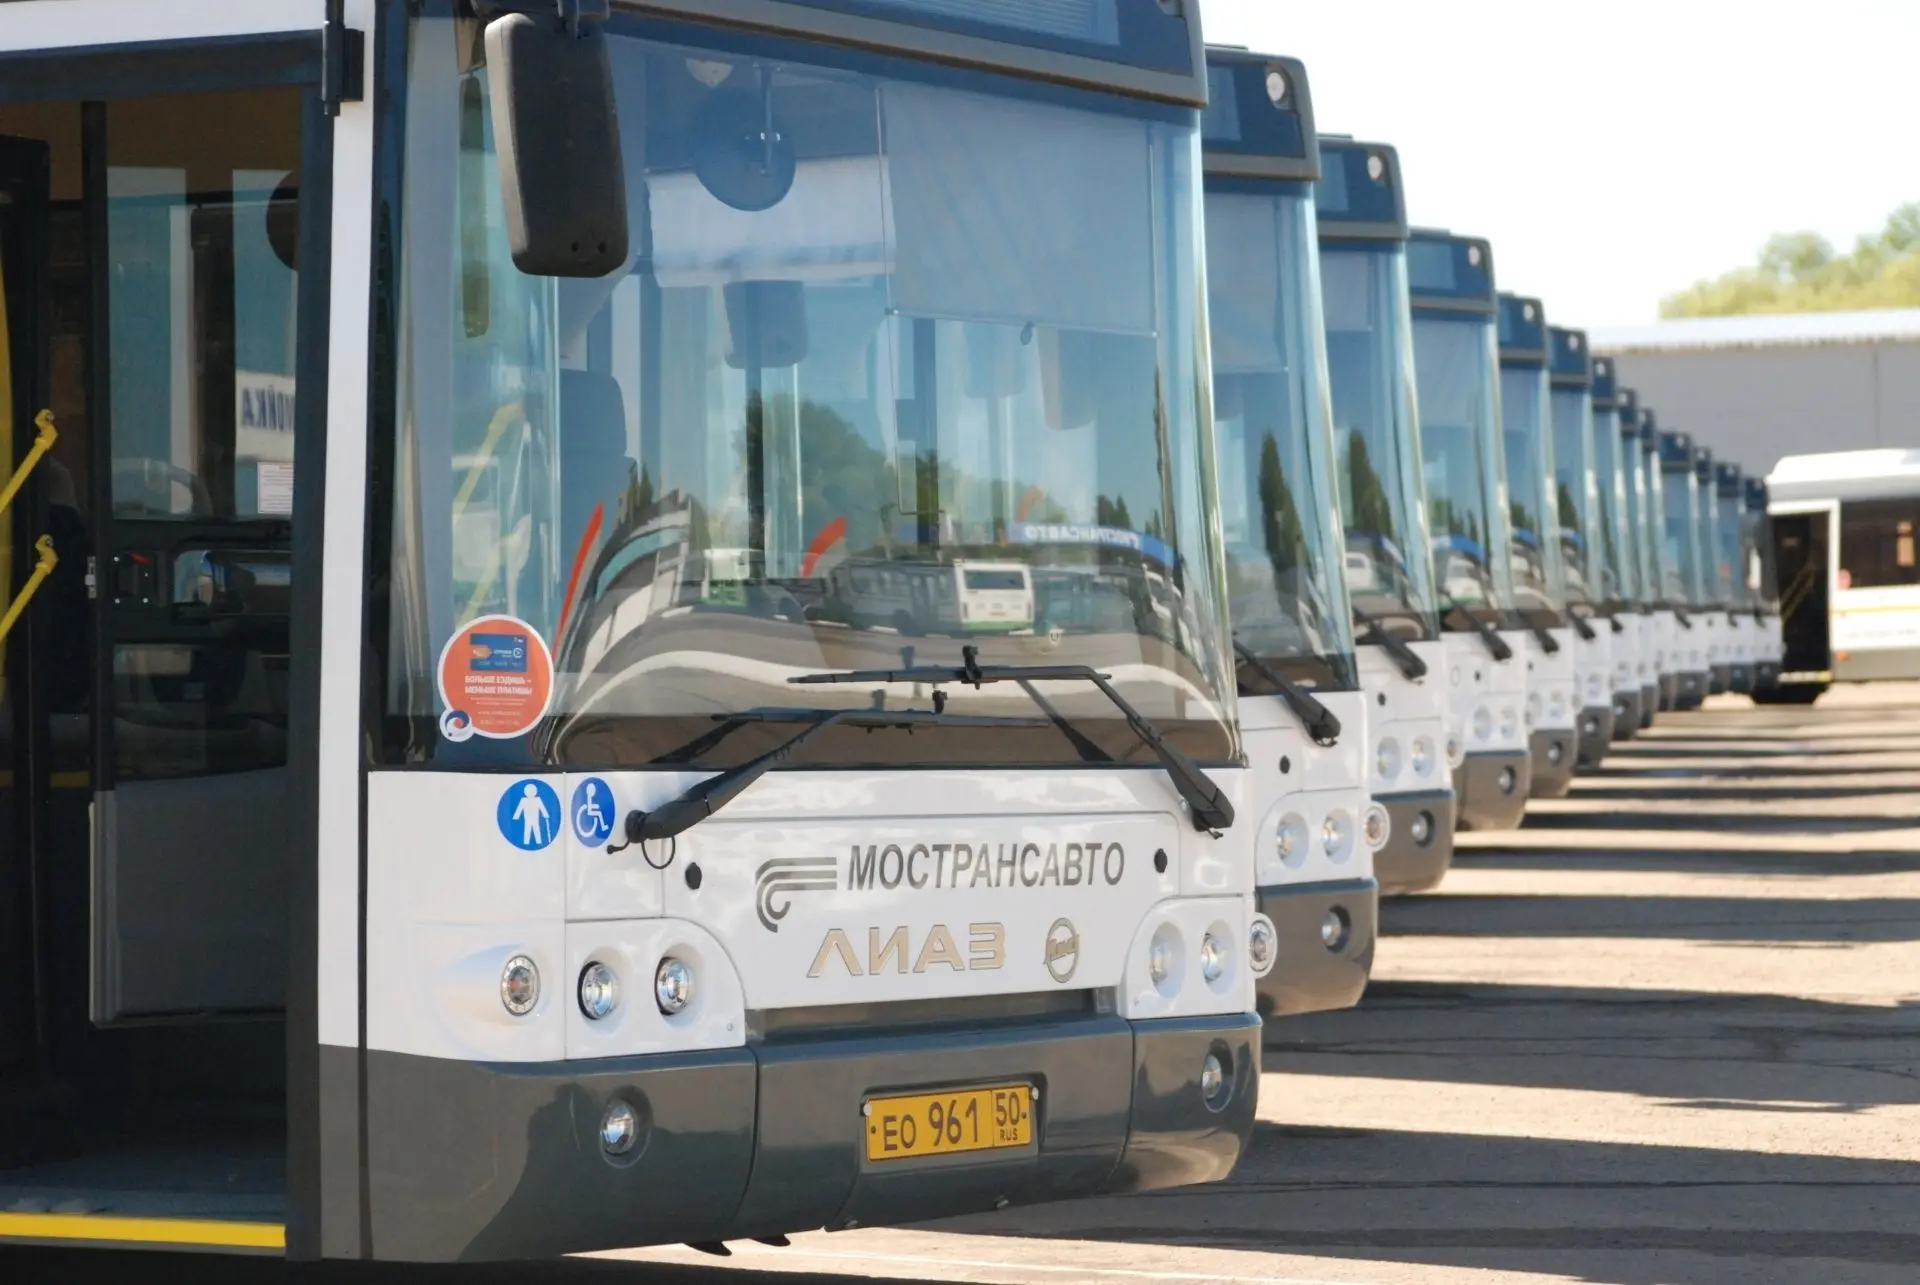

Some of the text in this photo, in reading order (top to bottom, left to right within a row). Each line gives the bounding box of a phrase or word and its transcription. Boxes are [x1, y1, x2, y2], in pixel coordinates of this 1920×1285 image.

[848, 842, 1125, 890] МОСТРАНСАВТО
[806, 922, 1006, 978] ЛИАЗ
[928, 1097, 979, 1147] 961
[995, 1092, 1020, 1127] 50
[1000, 1128, 1018, 1141] RUS
